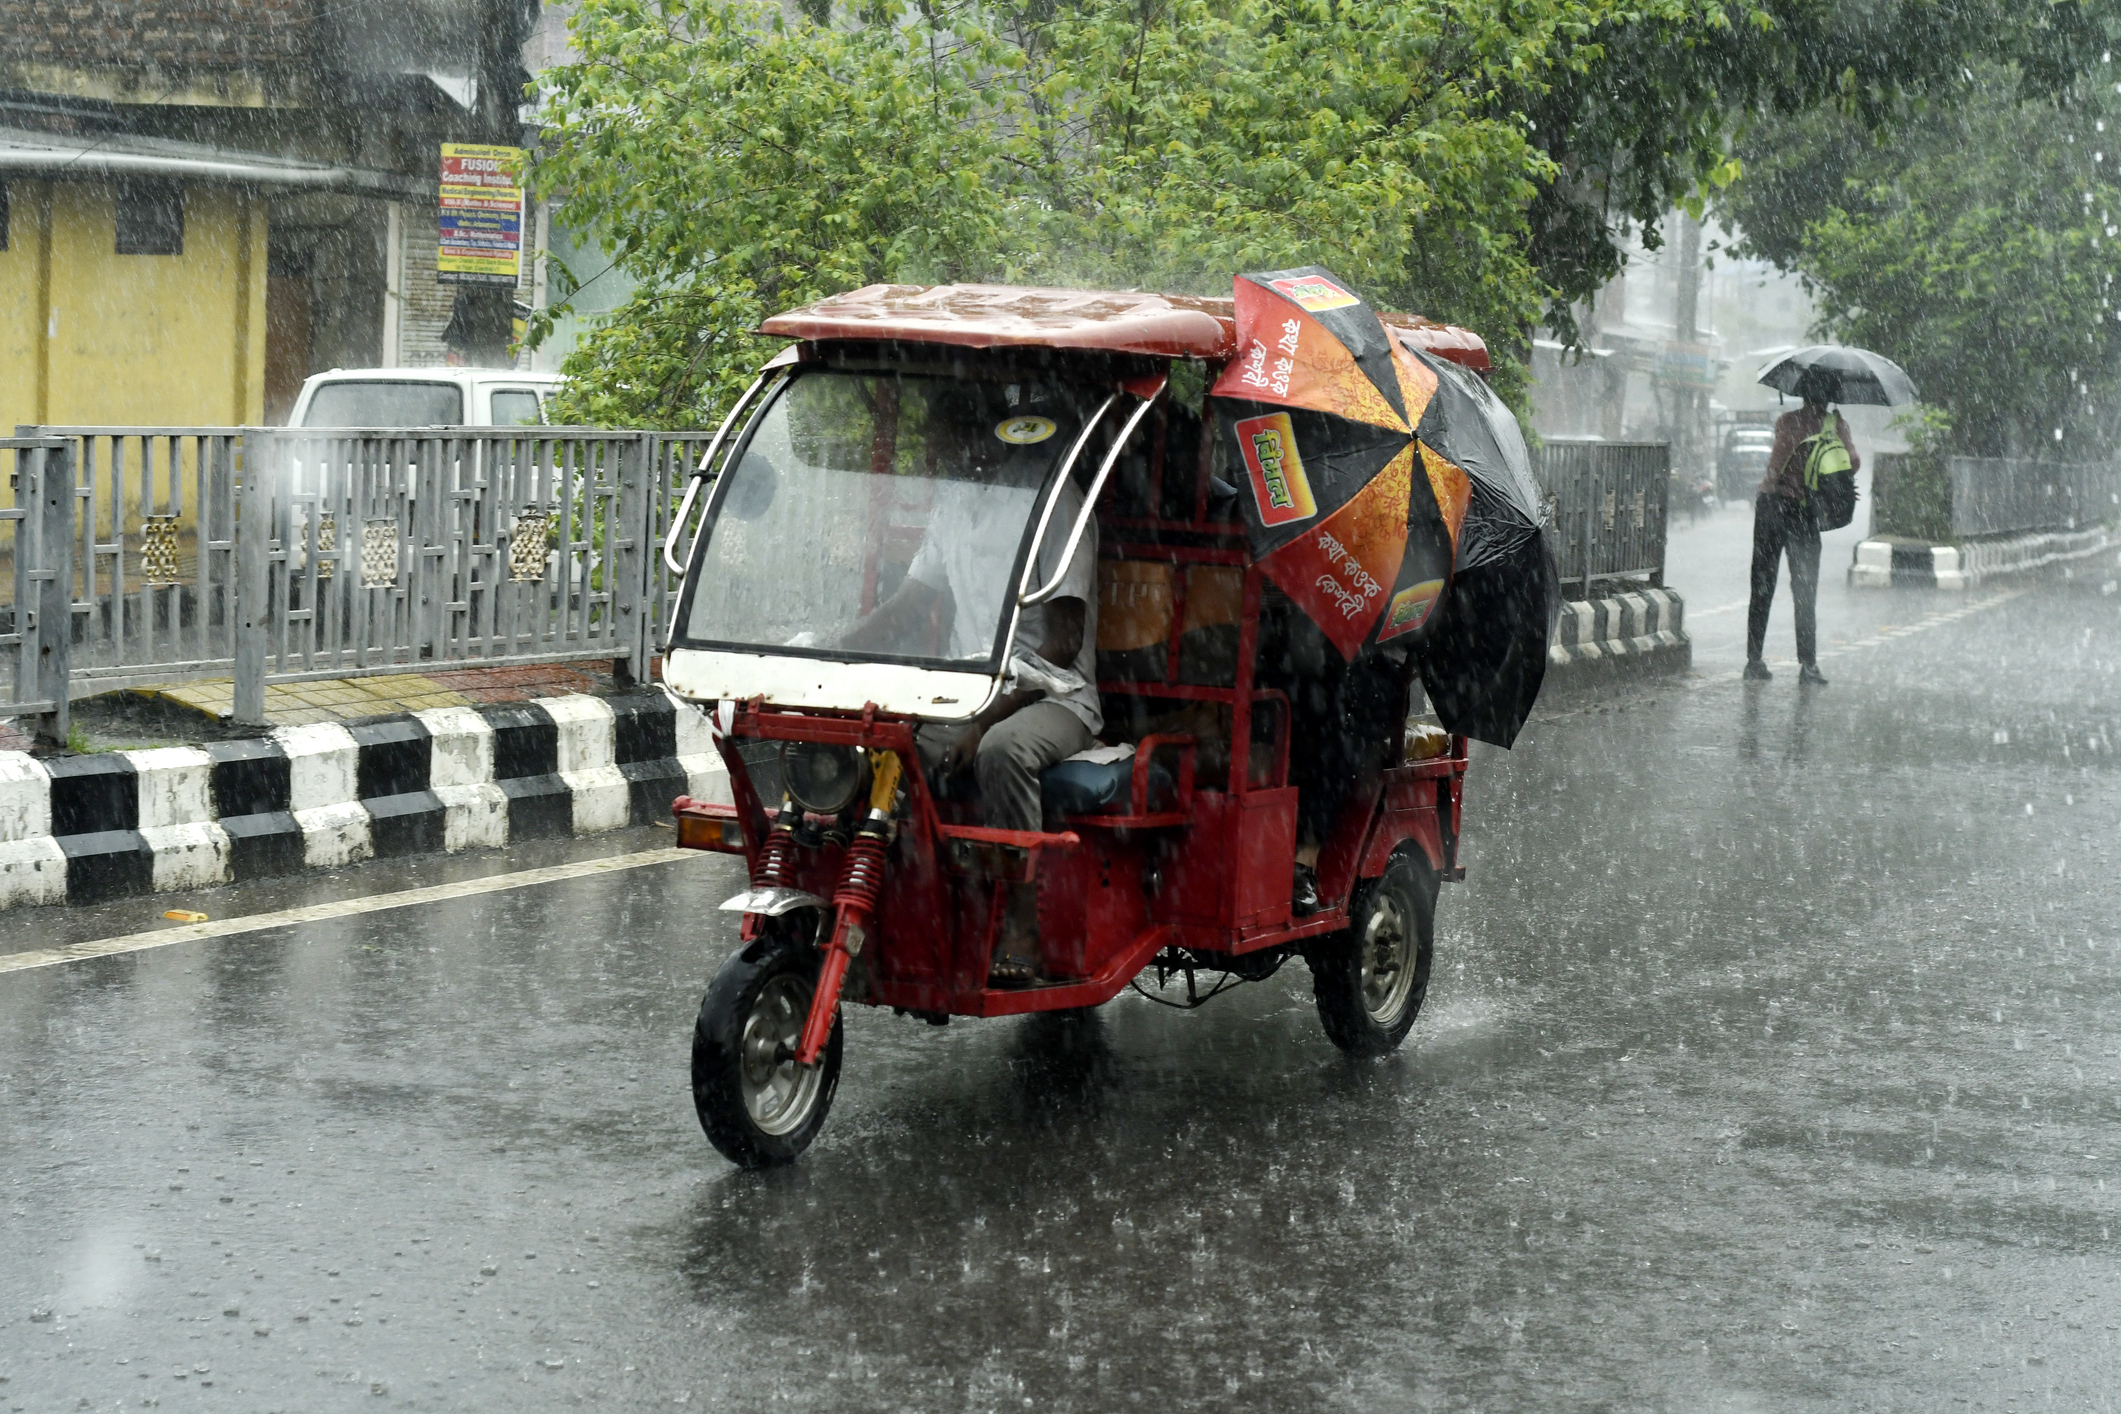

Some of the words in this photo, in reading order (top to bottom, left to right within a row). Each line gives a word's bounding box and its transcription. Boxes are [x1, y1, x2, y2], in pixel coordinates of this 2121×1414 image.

[454, 148, 490, 156] Admission
[442, 171, 482, 186] Coaching
[484, 173, 514, 186] Institu
[1277, 318, 1301, 356] কথা
[1269, 357, 1294, 398] কওক
[1318, 530, 1348, 564] কথা
[1344, 555, 1382, 597] কওক
